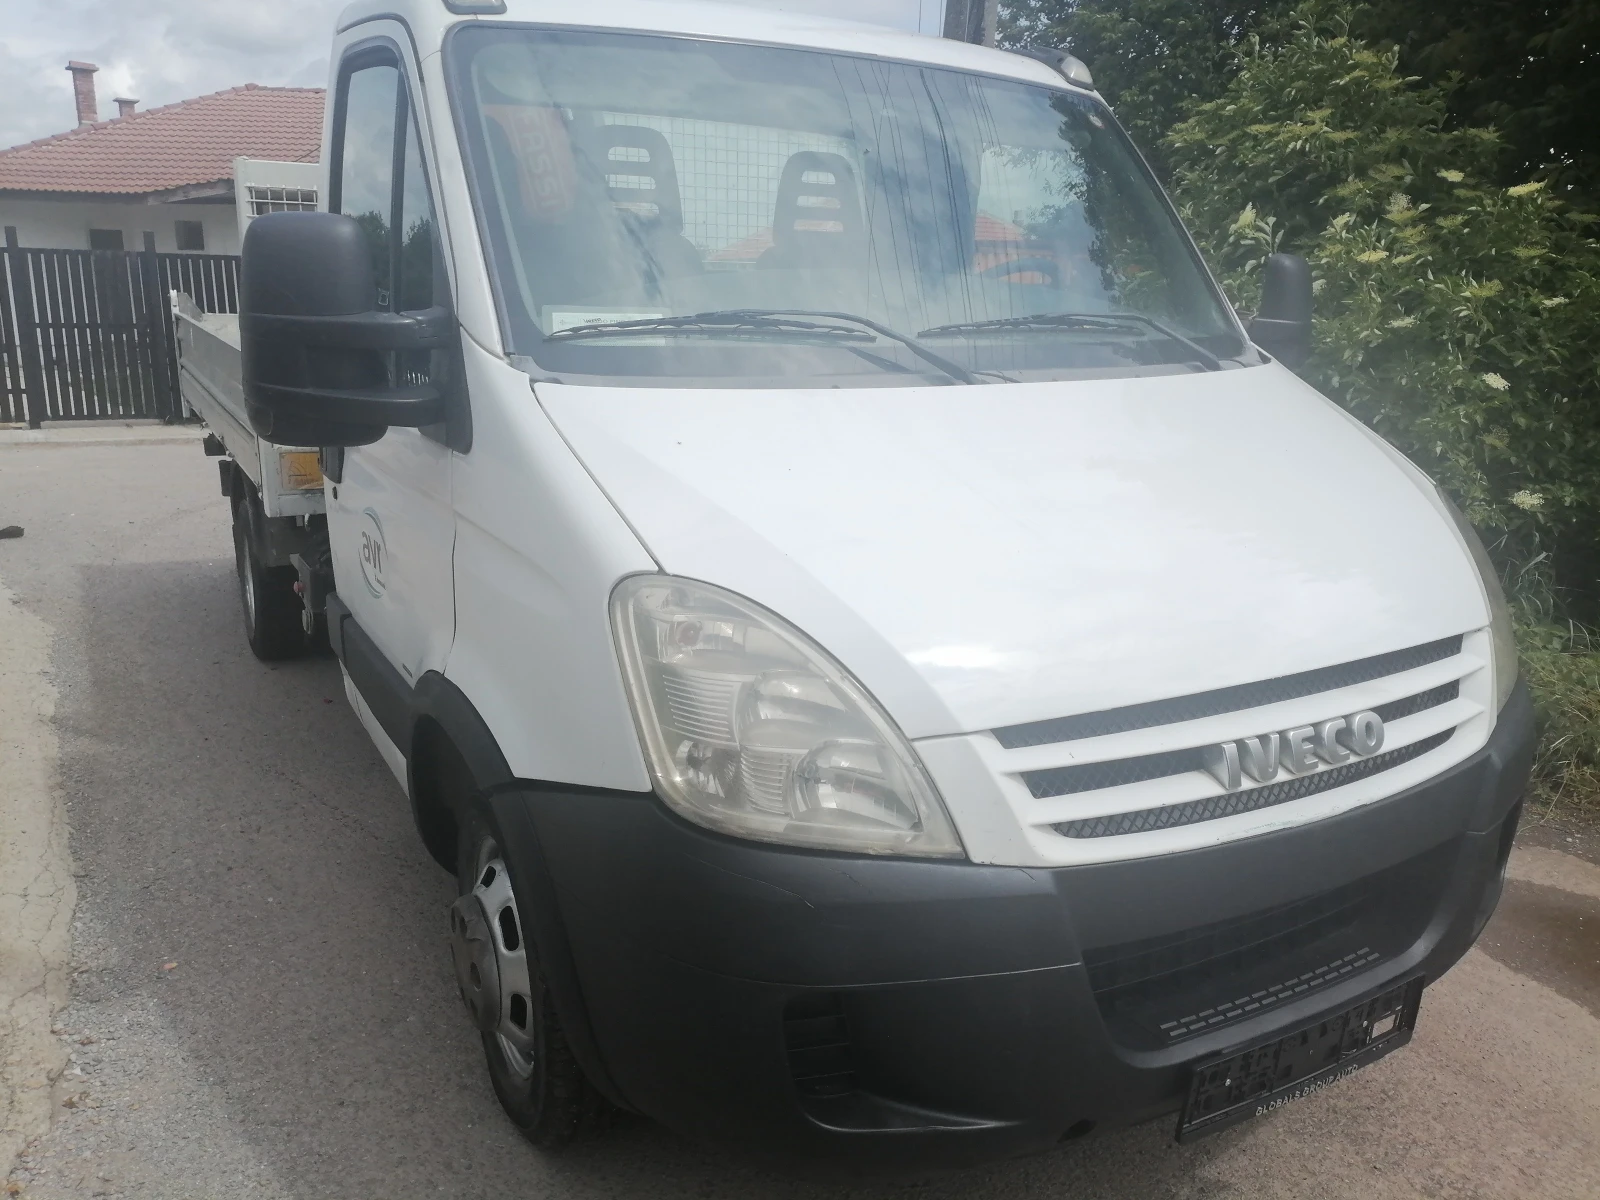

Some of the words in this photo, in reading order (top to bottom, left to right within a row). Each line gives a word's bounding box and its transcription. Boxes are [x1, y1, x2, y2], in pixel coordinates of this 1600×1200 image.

[515, 108, 562, 207] FASSI
[362, 530, 381, 574] avr
[1220, 710, 1385, 791] IVECO
[1256, 1091, 1300, 1116] GLOBALS
[1303, 1076, 1335, 1097] GROUP
